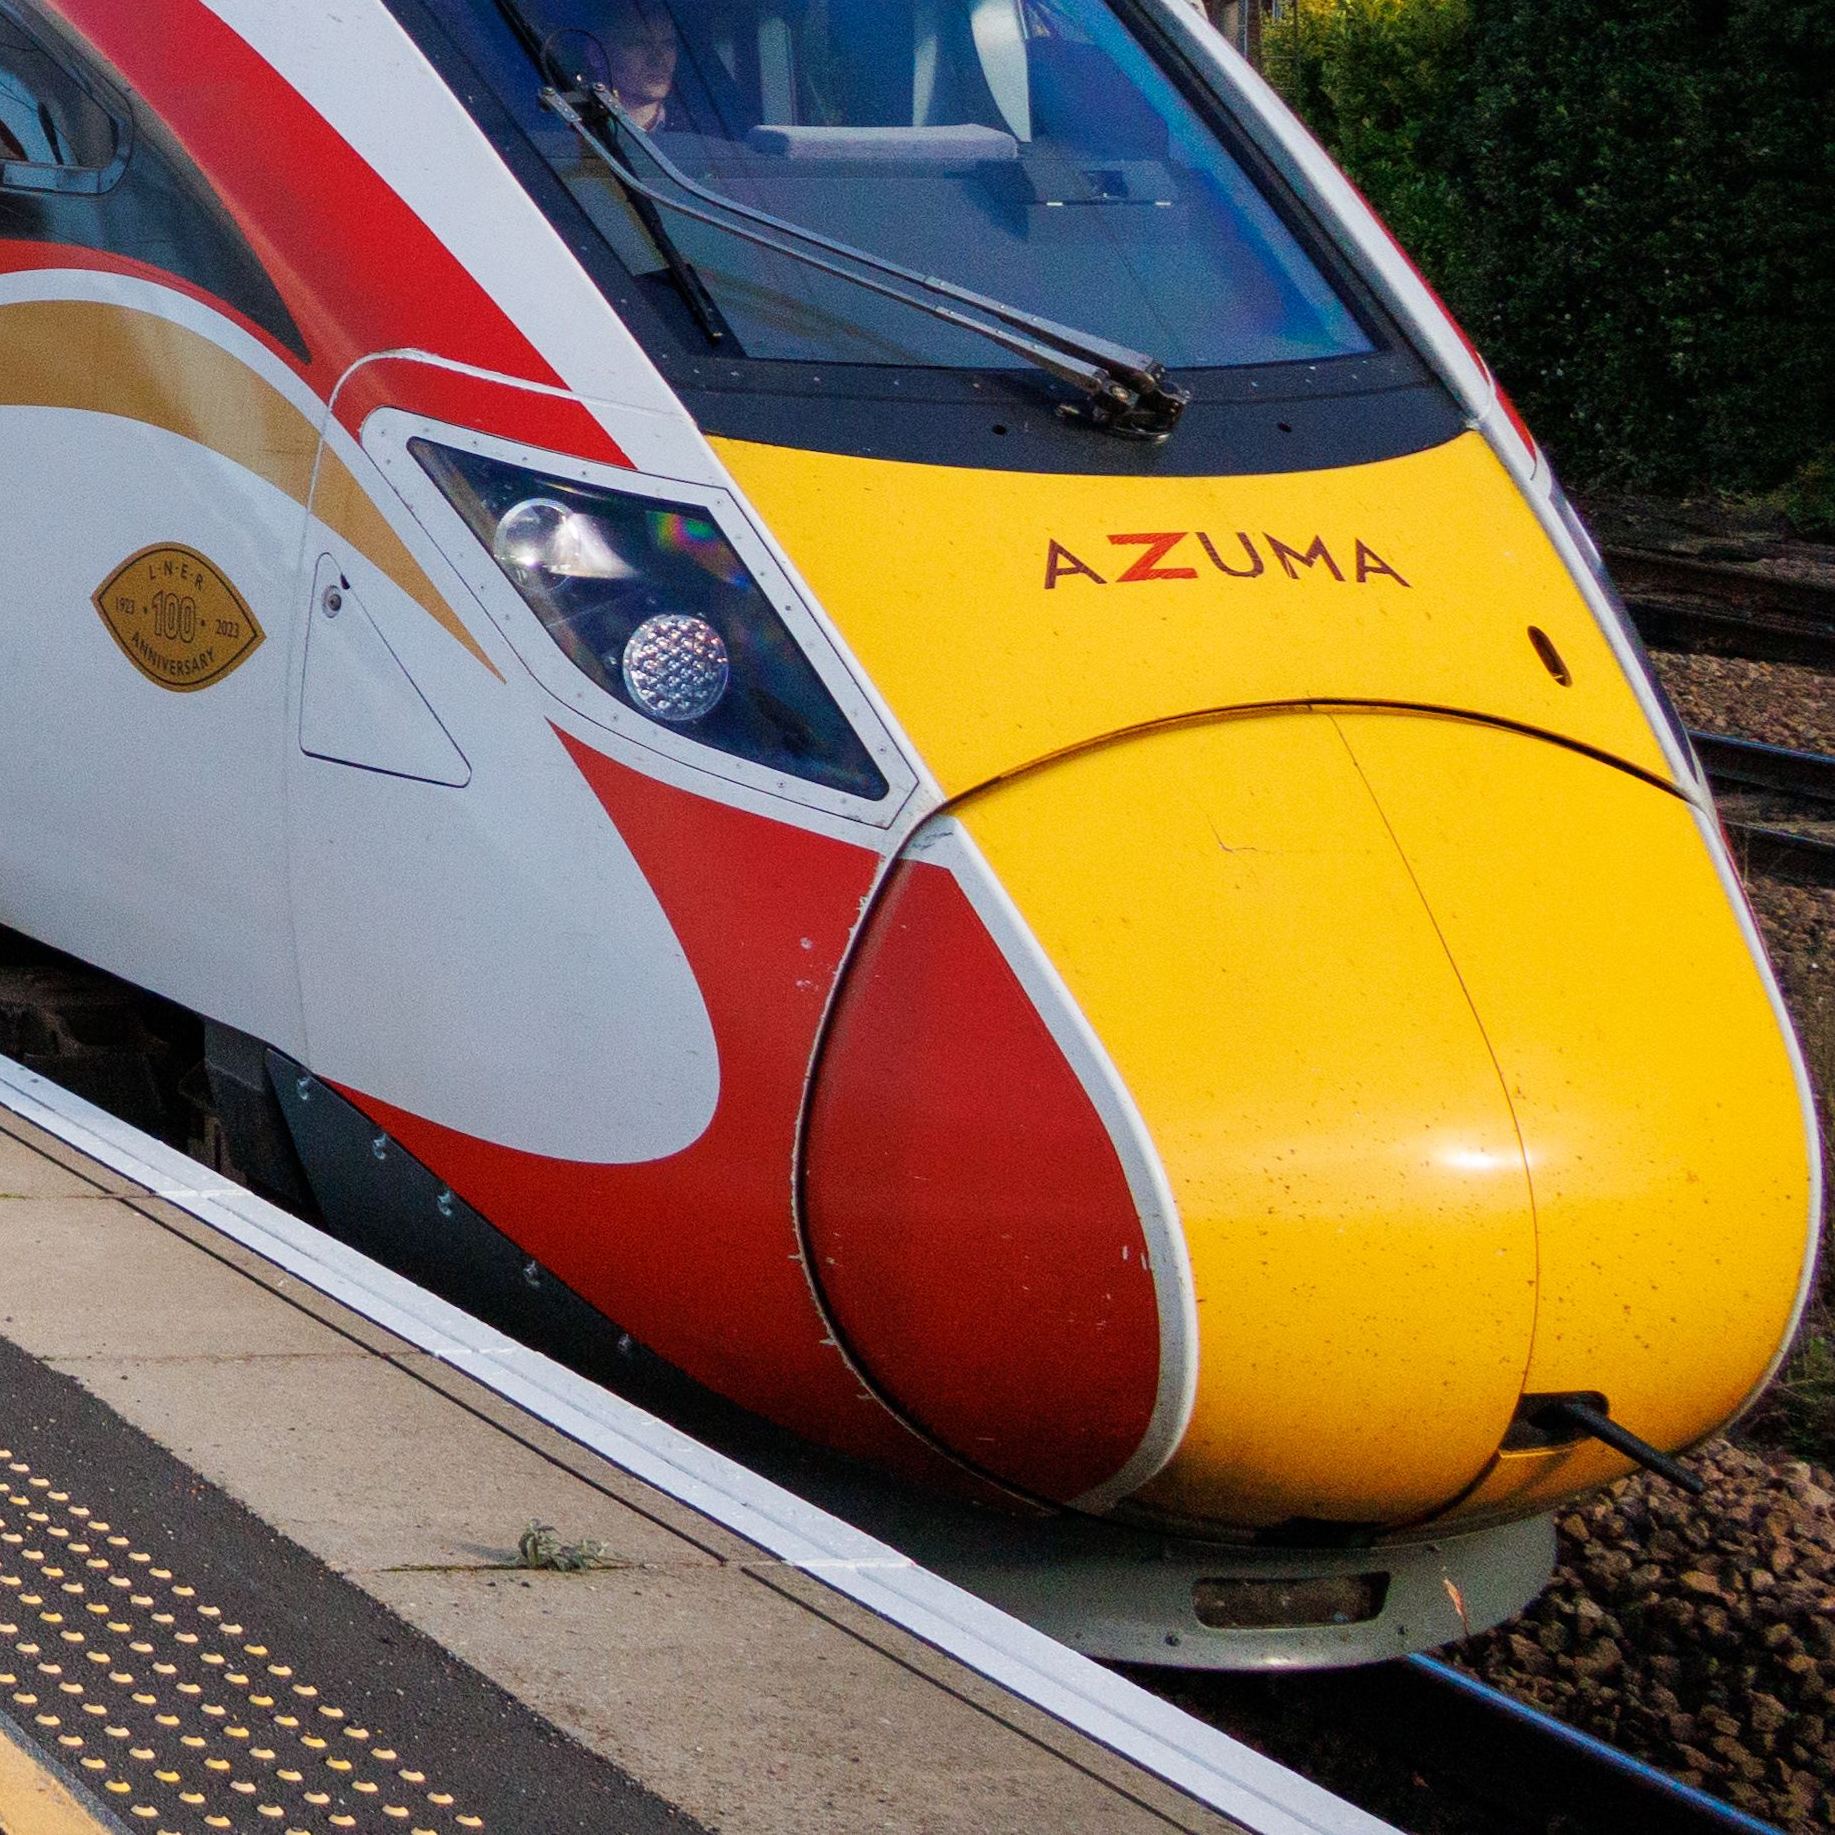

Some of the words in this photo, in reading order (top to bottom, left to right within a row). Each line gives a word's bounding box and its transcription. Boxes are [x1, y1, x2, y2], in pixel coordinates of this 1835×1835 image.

[1043, 531, 1412, 590] AZUMA
[115, 597, 135, 615] 1923
[151, 590, 196, 643] 100
[215, 619, 239, 639] 2023
[131, 632, 216, 676] ANNIVERSARY
